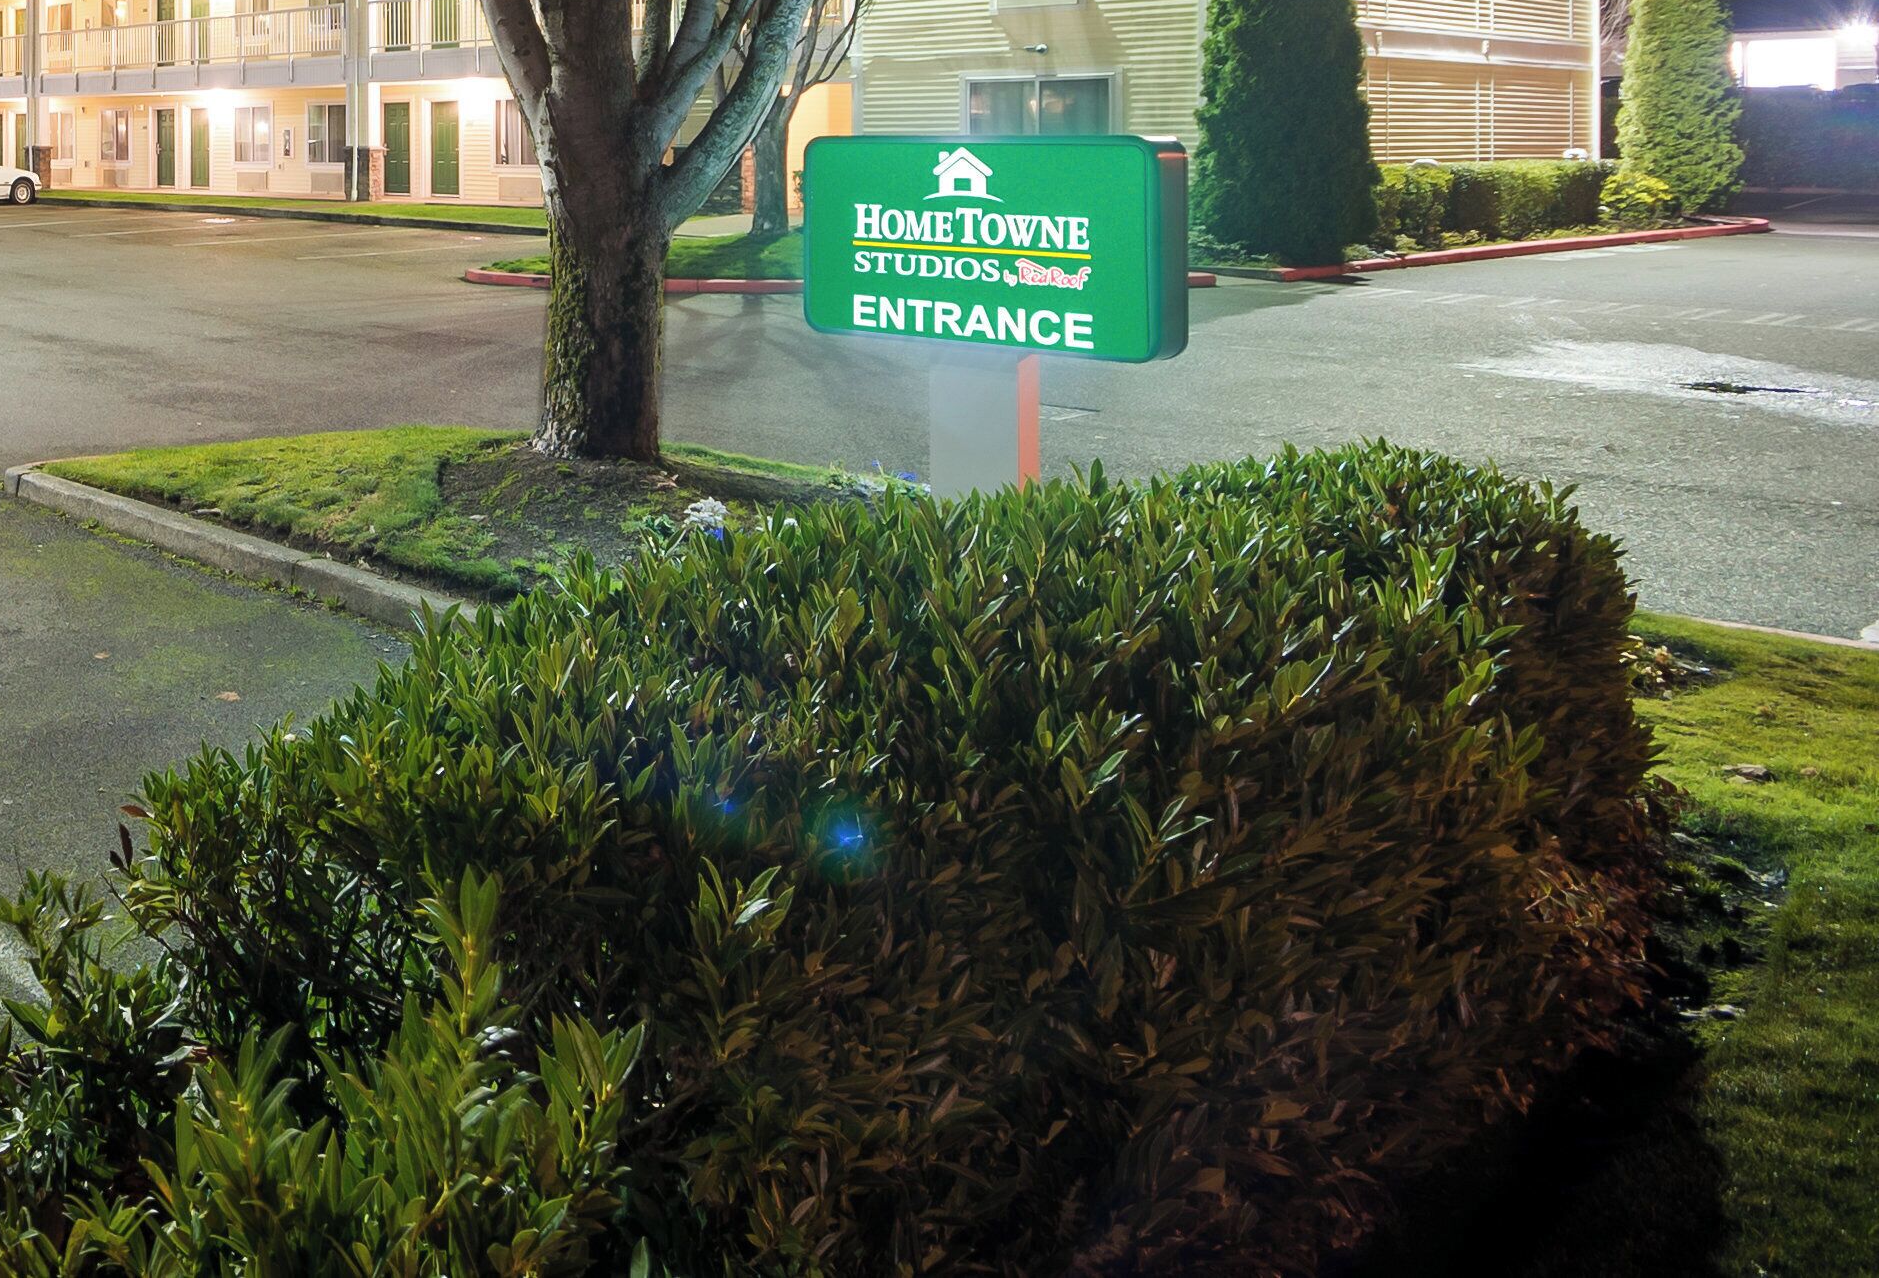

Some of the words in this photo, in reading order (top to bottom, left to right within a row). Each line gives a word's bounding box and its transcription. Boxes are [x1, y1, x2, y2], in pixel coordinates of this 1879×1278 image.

[853, 251, 1000, 282] STUDIOS
[1003, 269, 1018, 287] by
[1019, 262, 1049, 285] Red
[1049, 266, 1092, 290] Roof
[852, 293, 1095, 349] ENTRANCE
